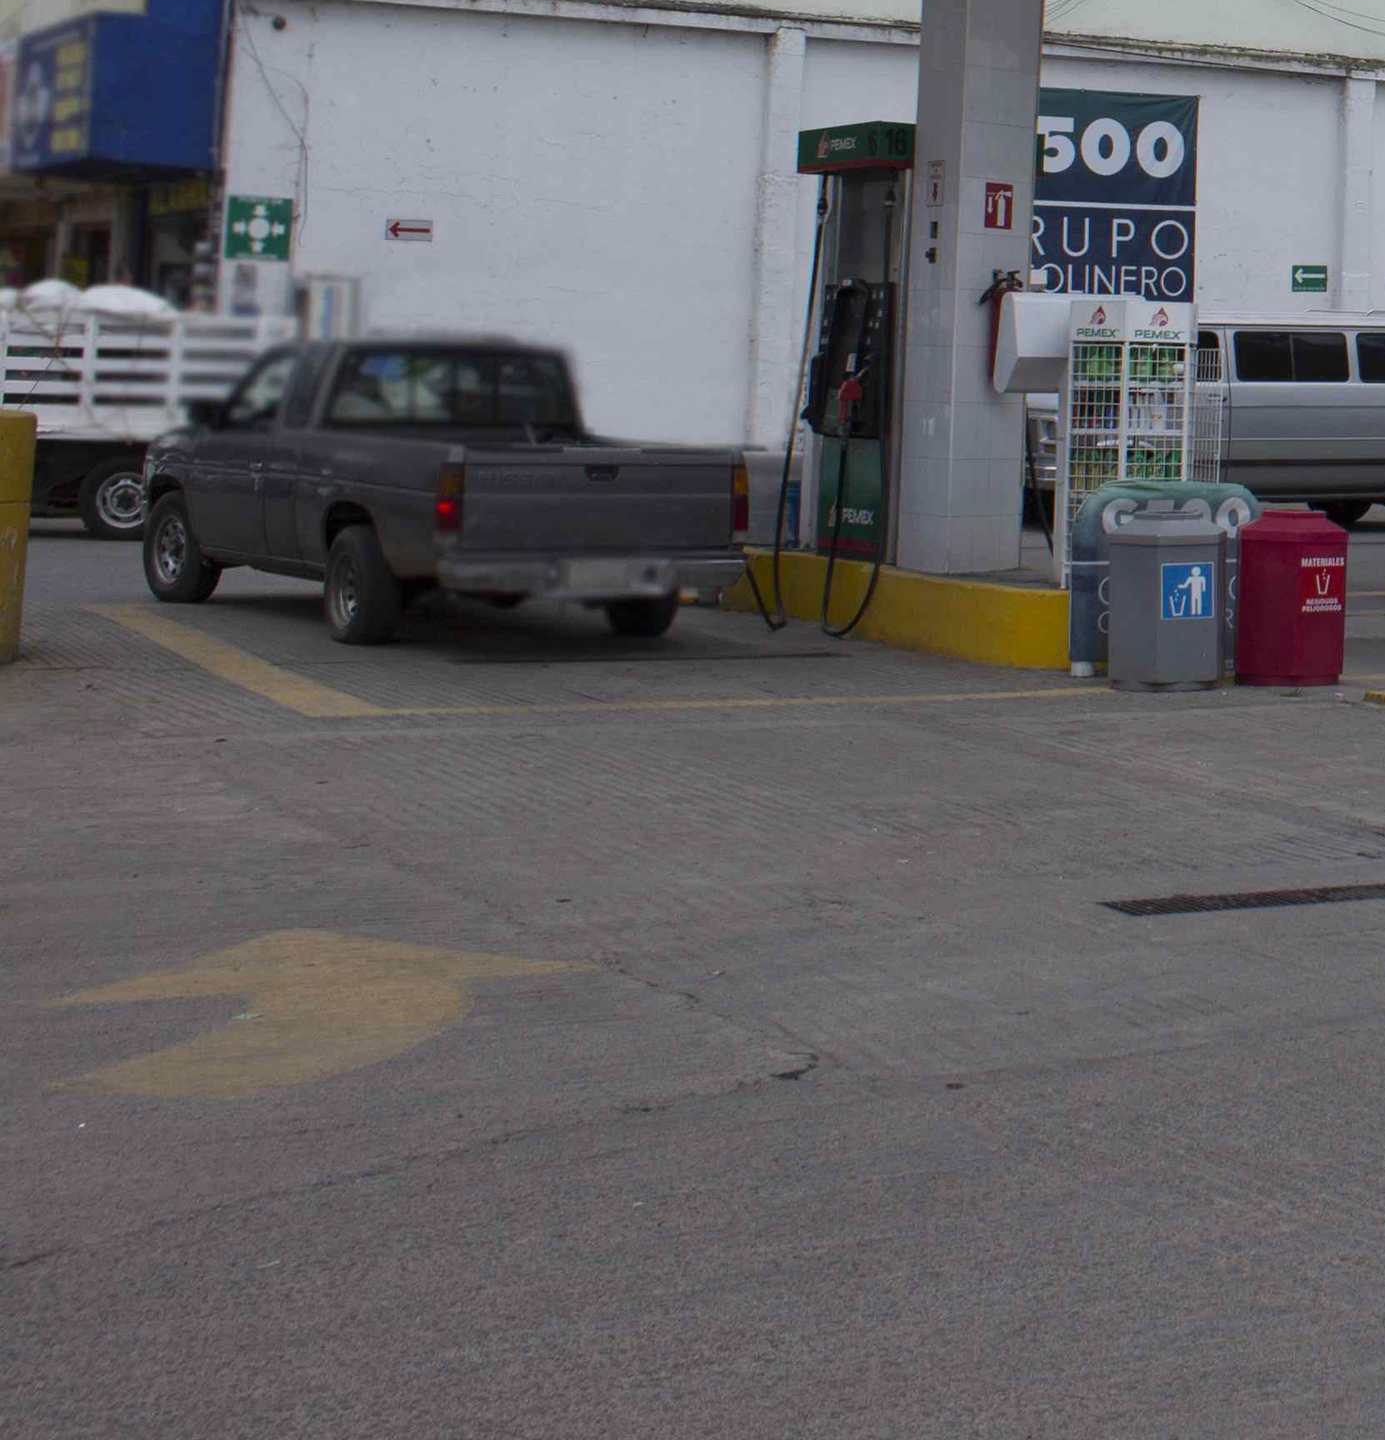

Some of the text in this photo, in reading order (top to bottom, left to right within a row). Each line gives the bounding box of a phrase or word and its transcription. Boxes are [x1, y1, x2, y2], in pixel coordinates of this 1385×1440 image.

[831, 136, 857, 151] PEMEX
[1037, 115, 1185, 178] 500
[1031, 263, 1187, 297] OLINERO
[1076, 328, 1116, 338] PEMEX
[1134, 329, 1180, 340] PEMEX
[841, 507, 874, 526] PEMEX
[1301, 557, 1344, 567] MATERIALES
